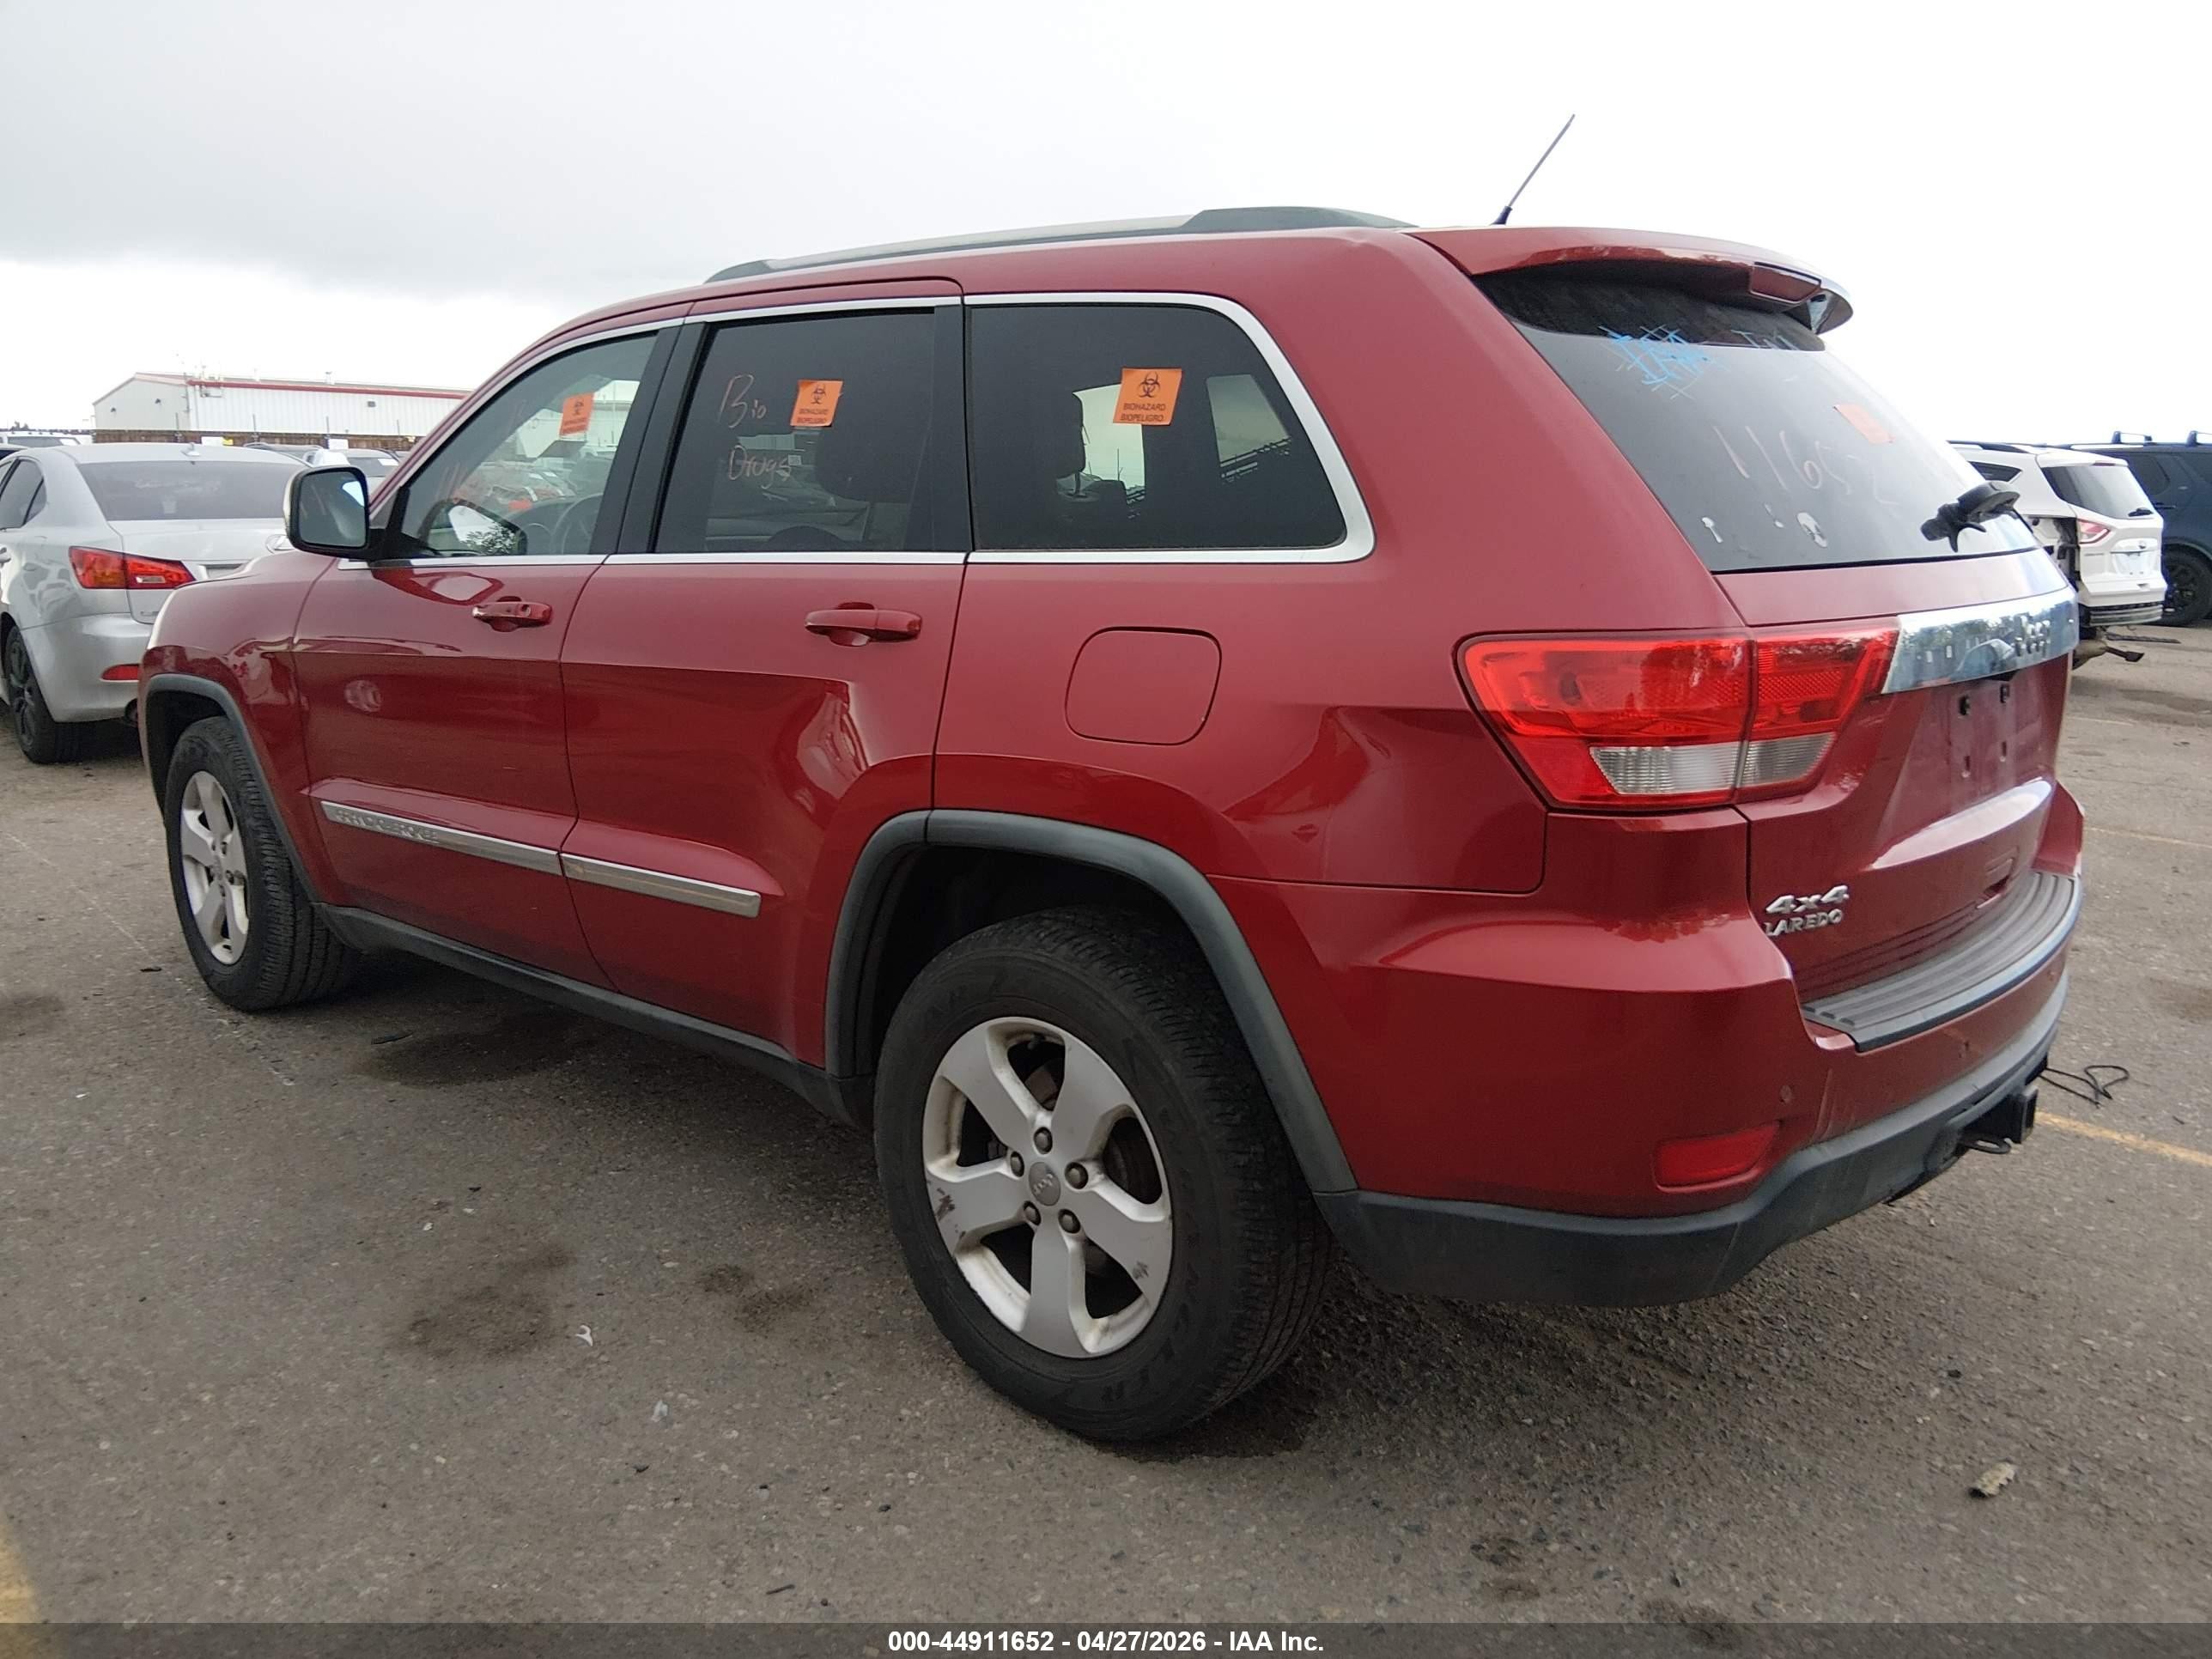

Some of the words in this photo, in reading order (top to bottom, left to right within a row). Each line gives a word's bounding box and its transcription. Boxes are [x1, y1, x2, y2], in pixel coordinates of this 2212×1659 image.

[1123, 403, 1166, 411] BIOHAZARD
[1120, 413, 1164, 422] BIOPELIGRO
[1765, 884, 1850, 914] 4x4
[1764, 908, 1843, 936] LAREDO
